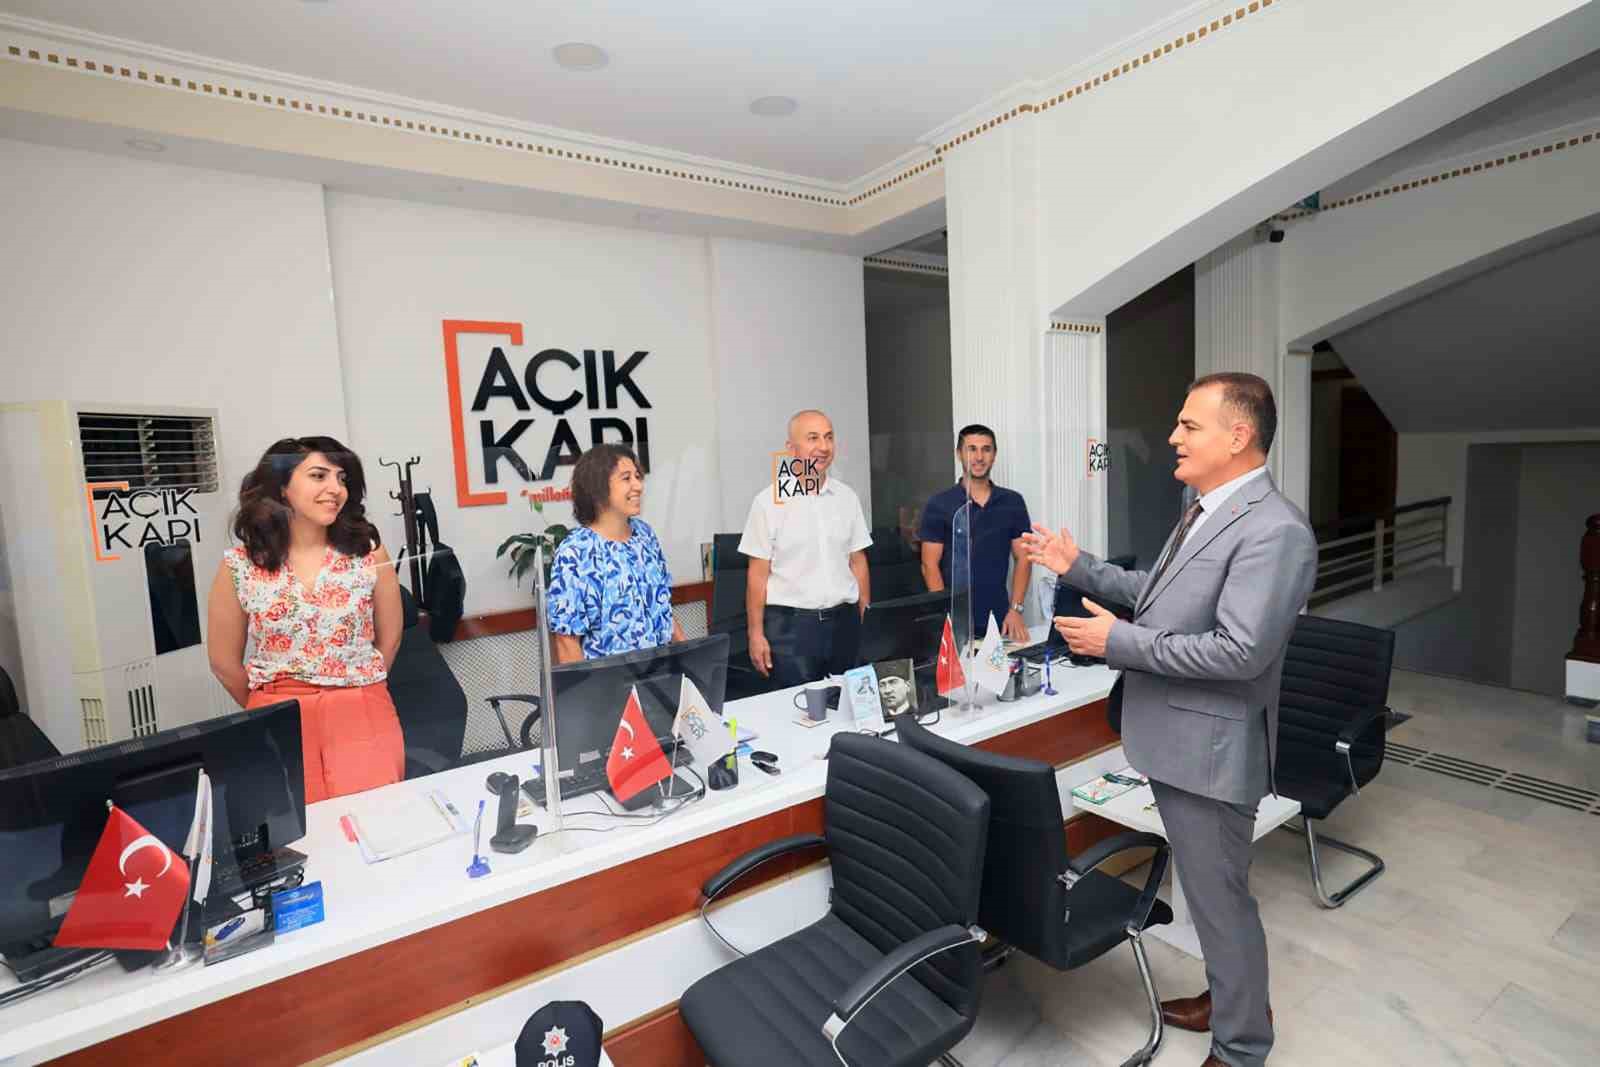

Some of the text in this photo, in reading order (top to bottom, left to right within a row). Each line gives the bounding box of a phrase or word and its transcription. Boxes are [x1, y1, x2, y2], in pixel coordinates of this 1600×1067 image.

[471, 347, 652, 415] AÇIK
[778, 458, 819, 477] AÇIK
[101, 488, 199, 520] AÇIK
[778, 478, 820, 498] KAPI
[103, 518, 201, 550] KAPI
